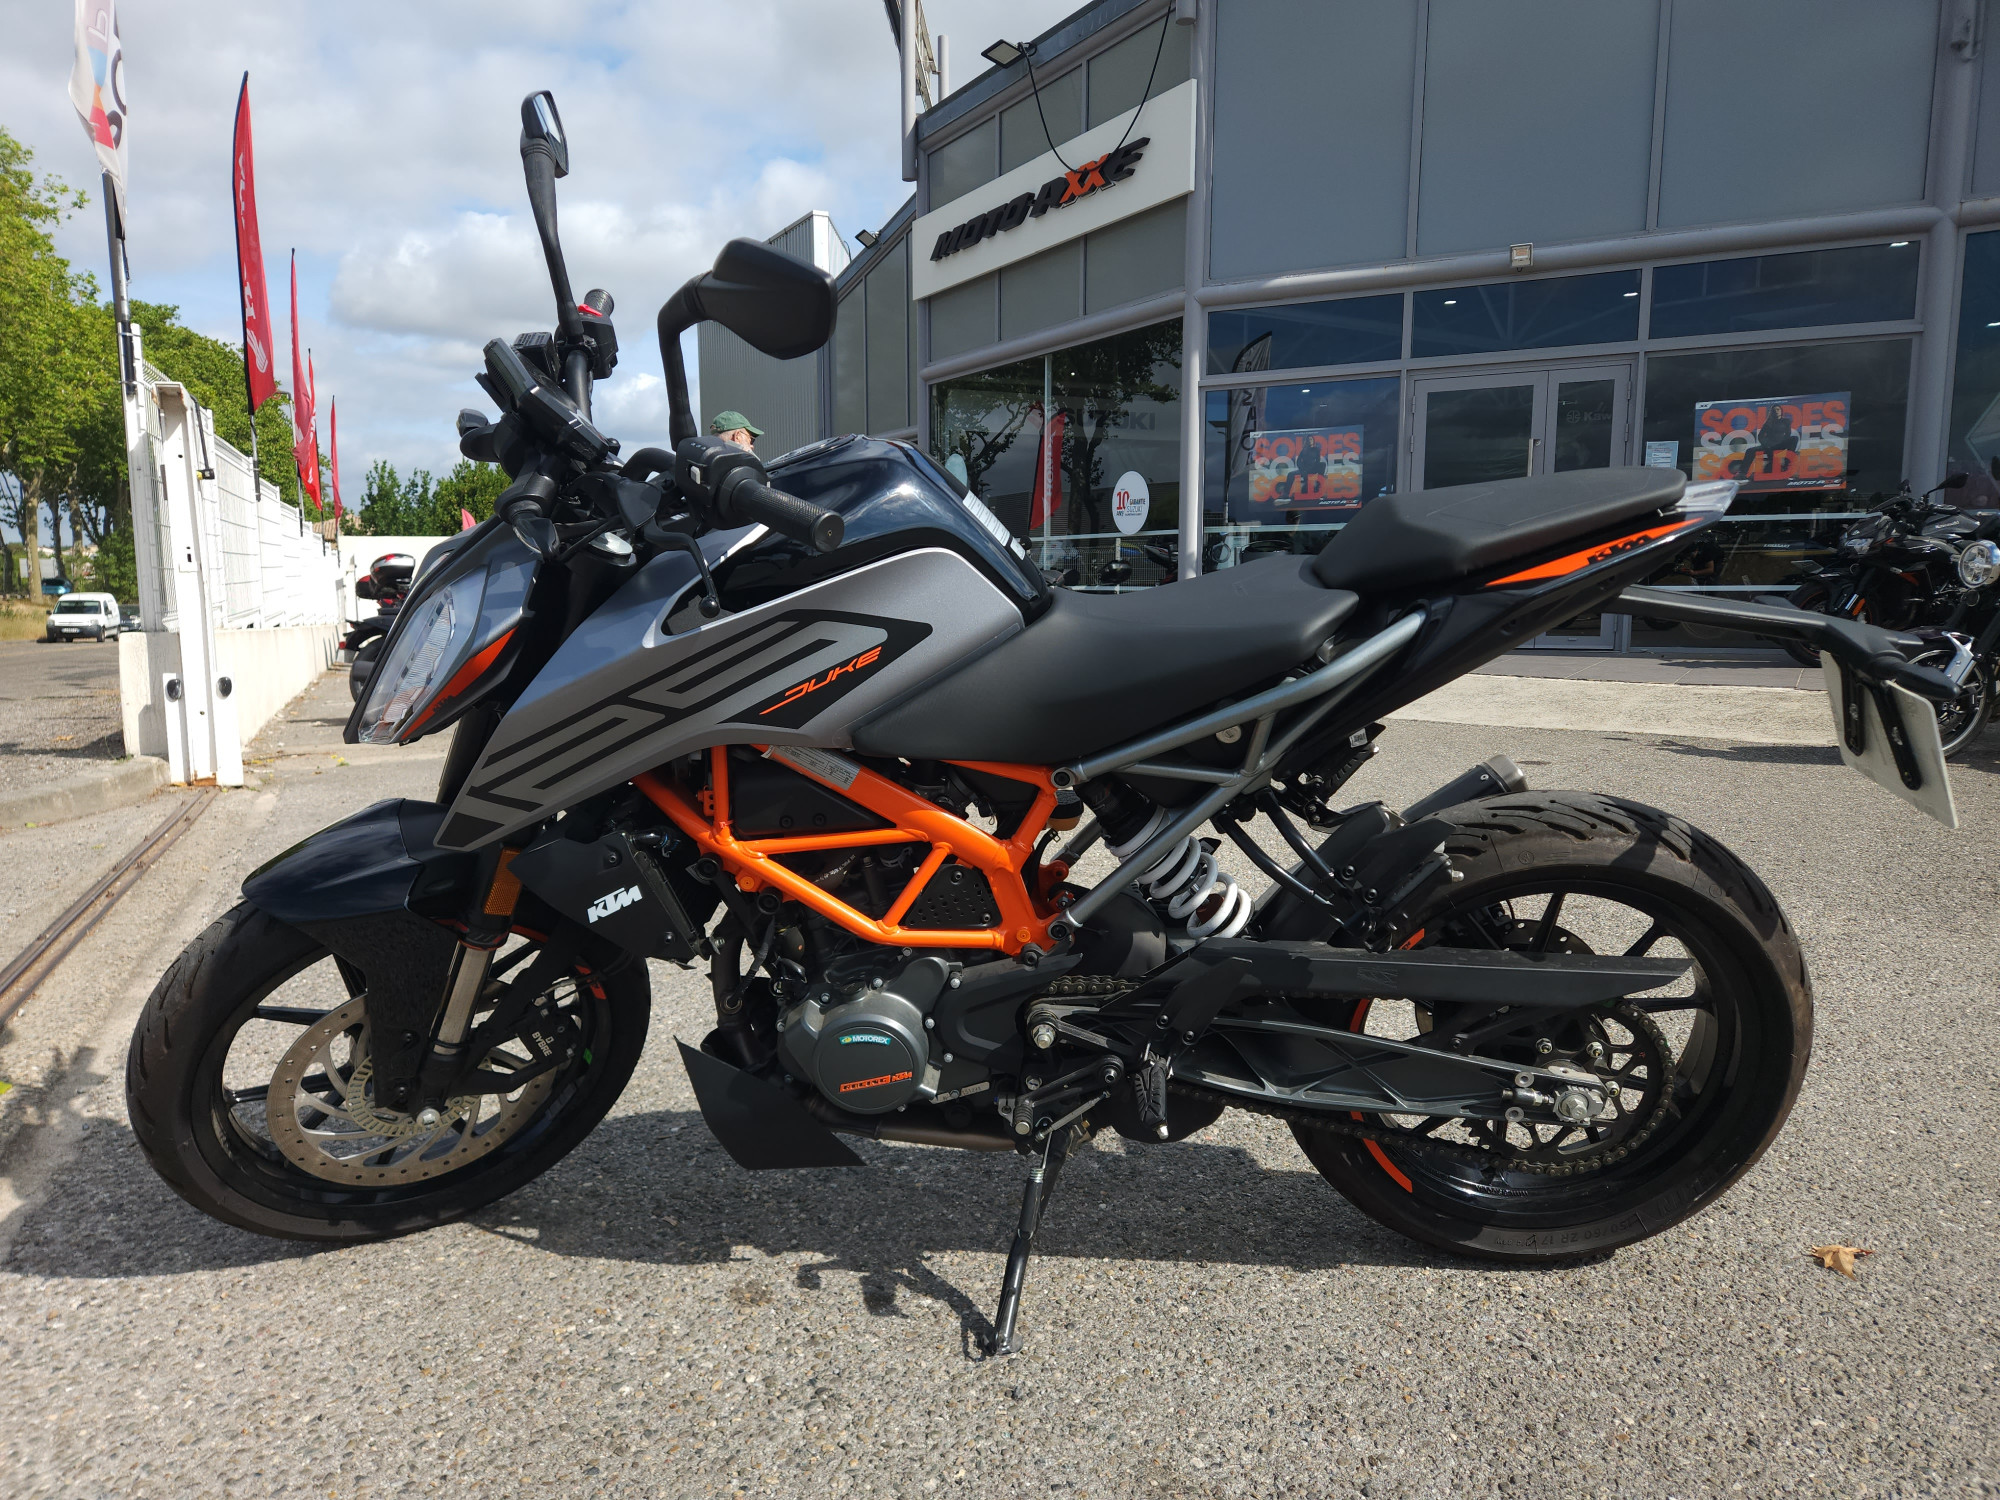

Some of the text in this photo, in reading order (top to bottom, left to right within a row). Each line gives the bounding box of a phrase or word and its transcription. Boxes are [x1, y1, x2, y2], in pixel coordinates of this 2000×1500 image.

[1701, 423, 1845, 452] SOES
[1254, 451, 1361, 476] SOES
[1116, 490, 1130, 510] 10
[1127, 505, 1143, 513] SUZUKI
[758, 646, 882, 715] DUKE
[587, 885, 643, 924] KTM
[531, 1031, 553, 1057] BYBRE
[852, 1034, 888, 1044] MOTOREX
